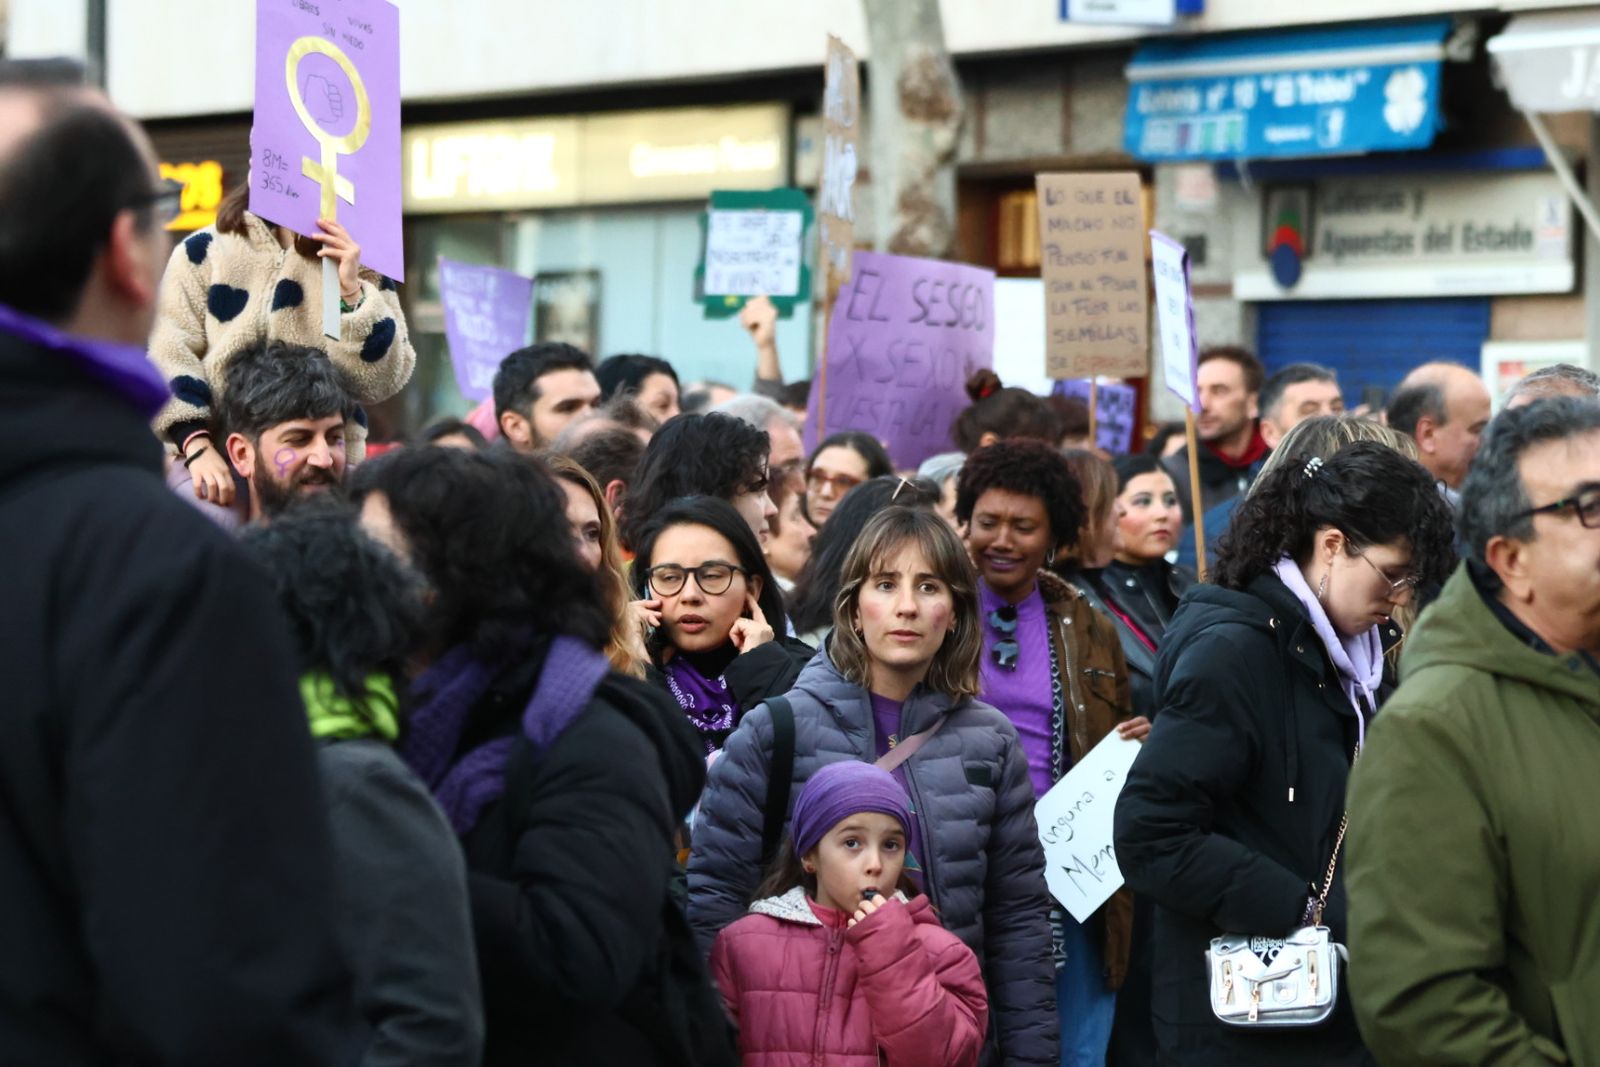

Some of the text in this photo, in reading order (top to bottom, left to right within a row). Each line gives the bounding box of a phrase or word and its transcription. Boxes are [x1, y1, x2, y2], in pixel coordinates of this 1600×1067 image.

[262, 148, 289, 171] 8M=
[260, 170, 284, 194] 365
[1045, 187, 1135, 207] LO QUE EL
[1461, 217, 1534, 252] Estado
[846, 268, 890, 322] EL
[907, 276, 986, 332] SESGO
[832, 336, 958, 392] X SEXO
[1042, 791, 1095, 844] inguna
